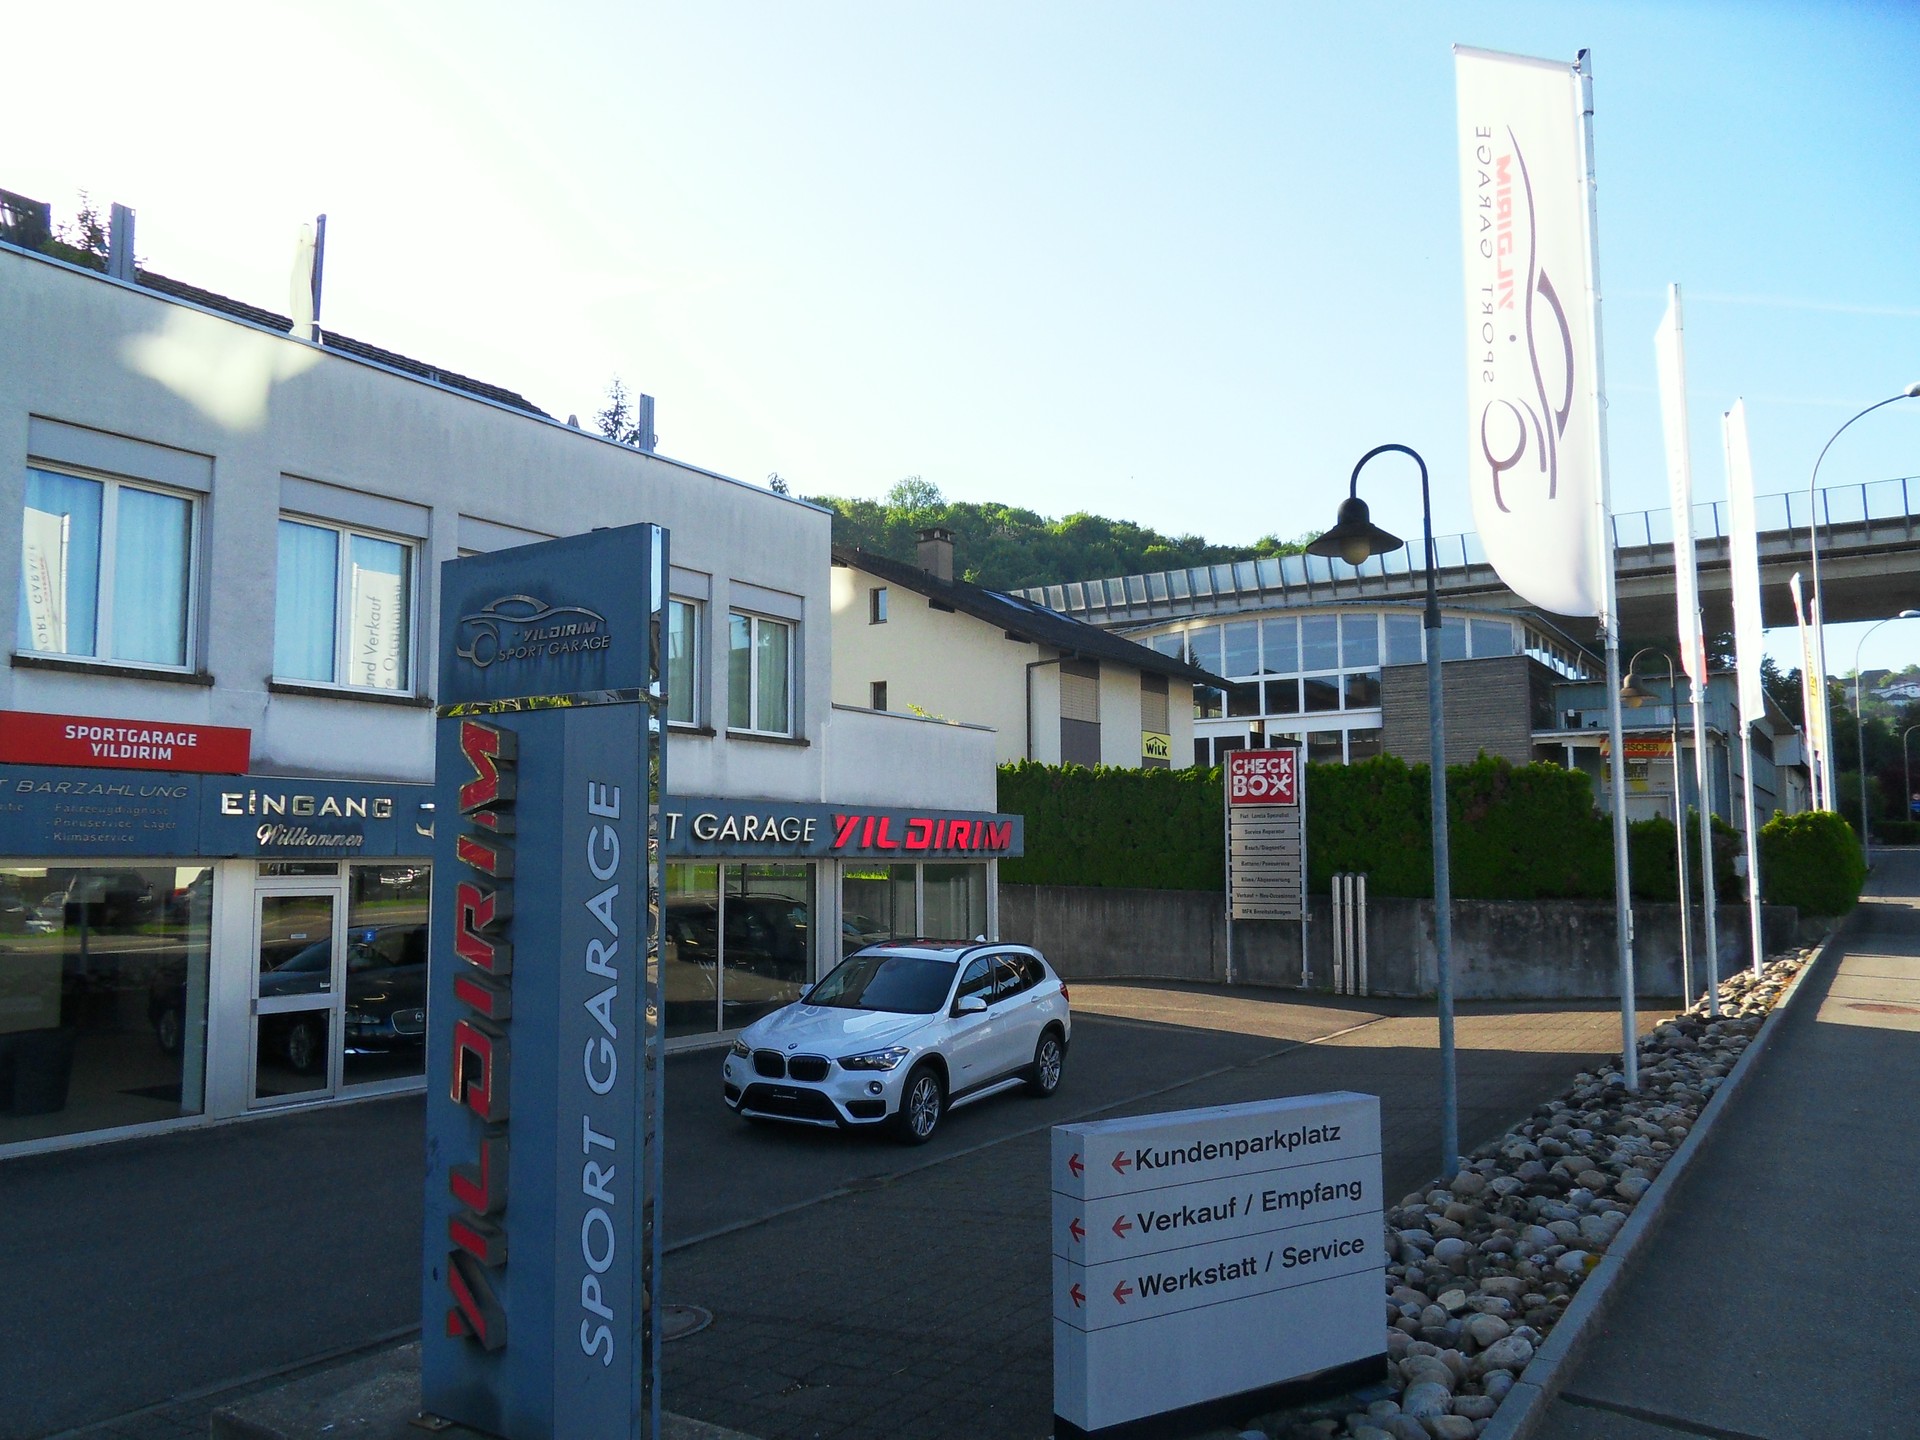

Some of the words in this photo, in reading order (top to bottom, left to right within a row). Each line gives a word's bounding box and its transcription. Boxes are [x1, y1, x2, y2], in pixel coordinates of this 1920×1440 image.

[363, 595, 382, 656] Verkauf
[523, 621, 598, 642] YILDIRIM
[499, 644, 545, 662] SPORT
[548, 635, 611, 655] GARAGE
[65, 725, 198, 747] SPORTGARAGE
[91, 743, 172, 761] YILDIRIM
[1232, 758, 1292, 775] CHECK
[16, 780, 188, 799] BARZAHLUNG
[1232, 774, 1292, 797] BOX
[256, 823, 365, 847] Willkommen
[693, 812, 818, 843] GARAGE
[830, 813, 1013, 851] YILDIRIM
[583, 780, 621, 1095] GARAGE
[1136, 1124, 1341, 1171] Kundenparkplatz
[1137, 1197, 1236, 1233] Verkauf
[1262, 1180, 1362, 1213] Empfang
[580, 1115, 616, 1368] SPORT
[1138, 1256, 1257, 1298] Werkstatt
[1282, 1237, 1365, 1269] Service
